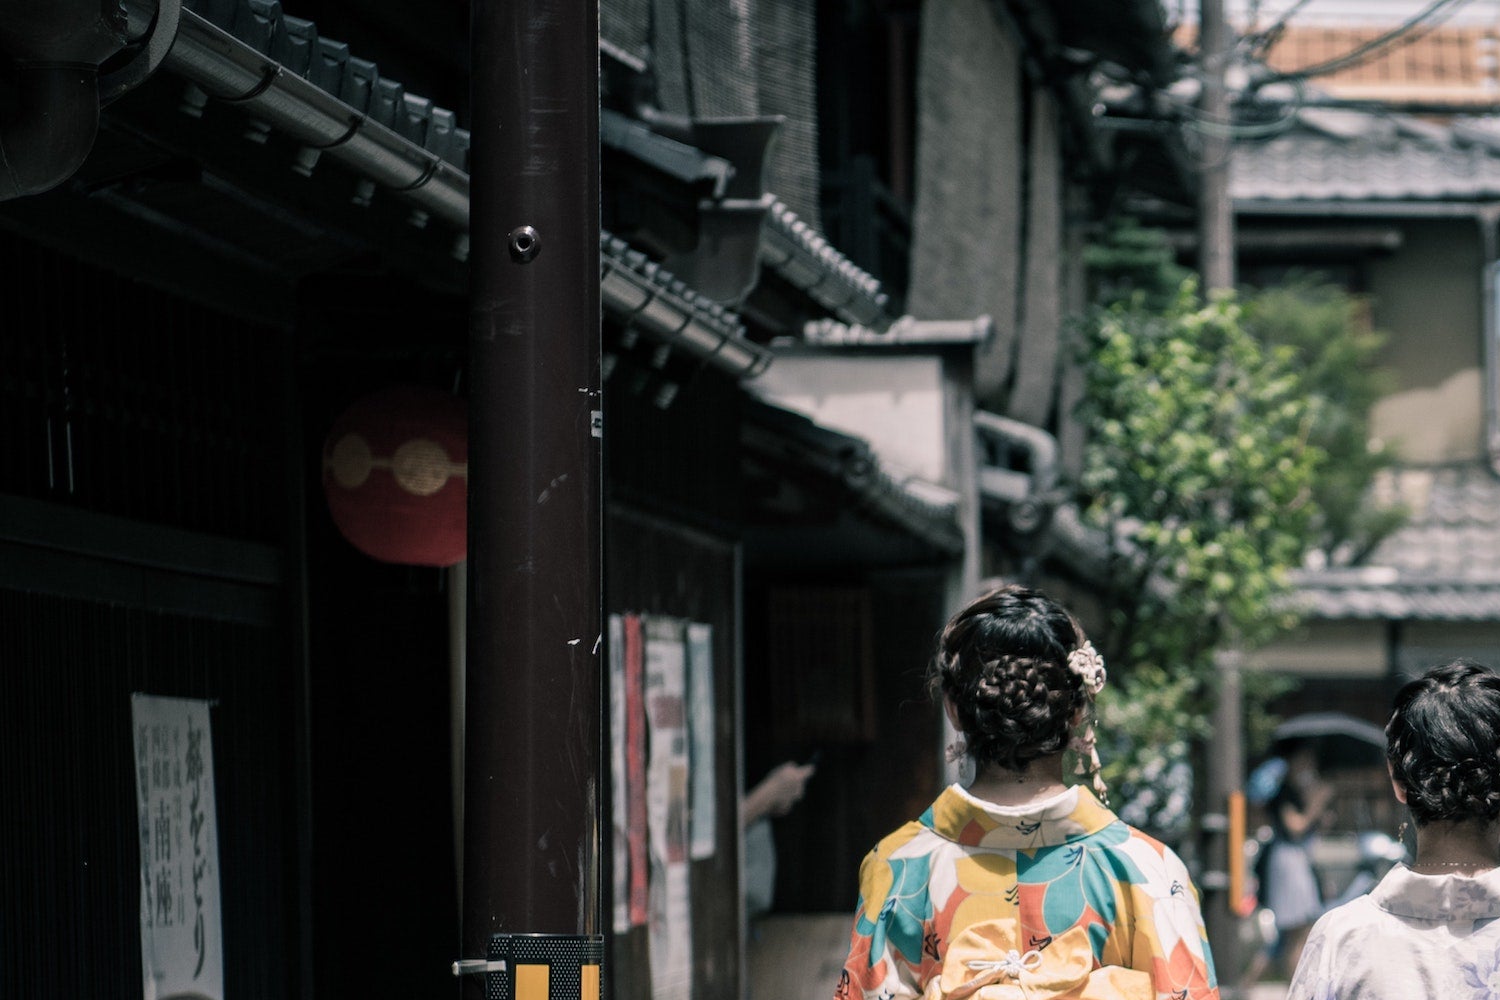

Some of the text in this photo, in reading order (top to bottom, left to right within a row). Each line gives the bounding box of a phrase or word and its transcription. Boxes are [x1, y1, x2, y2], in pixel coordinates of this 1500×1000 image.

[155, 797, 172, 927] 南座
[186, 715, 206, 981] 都をどり
